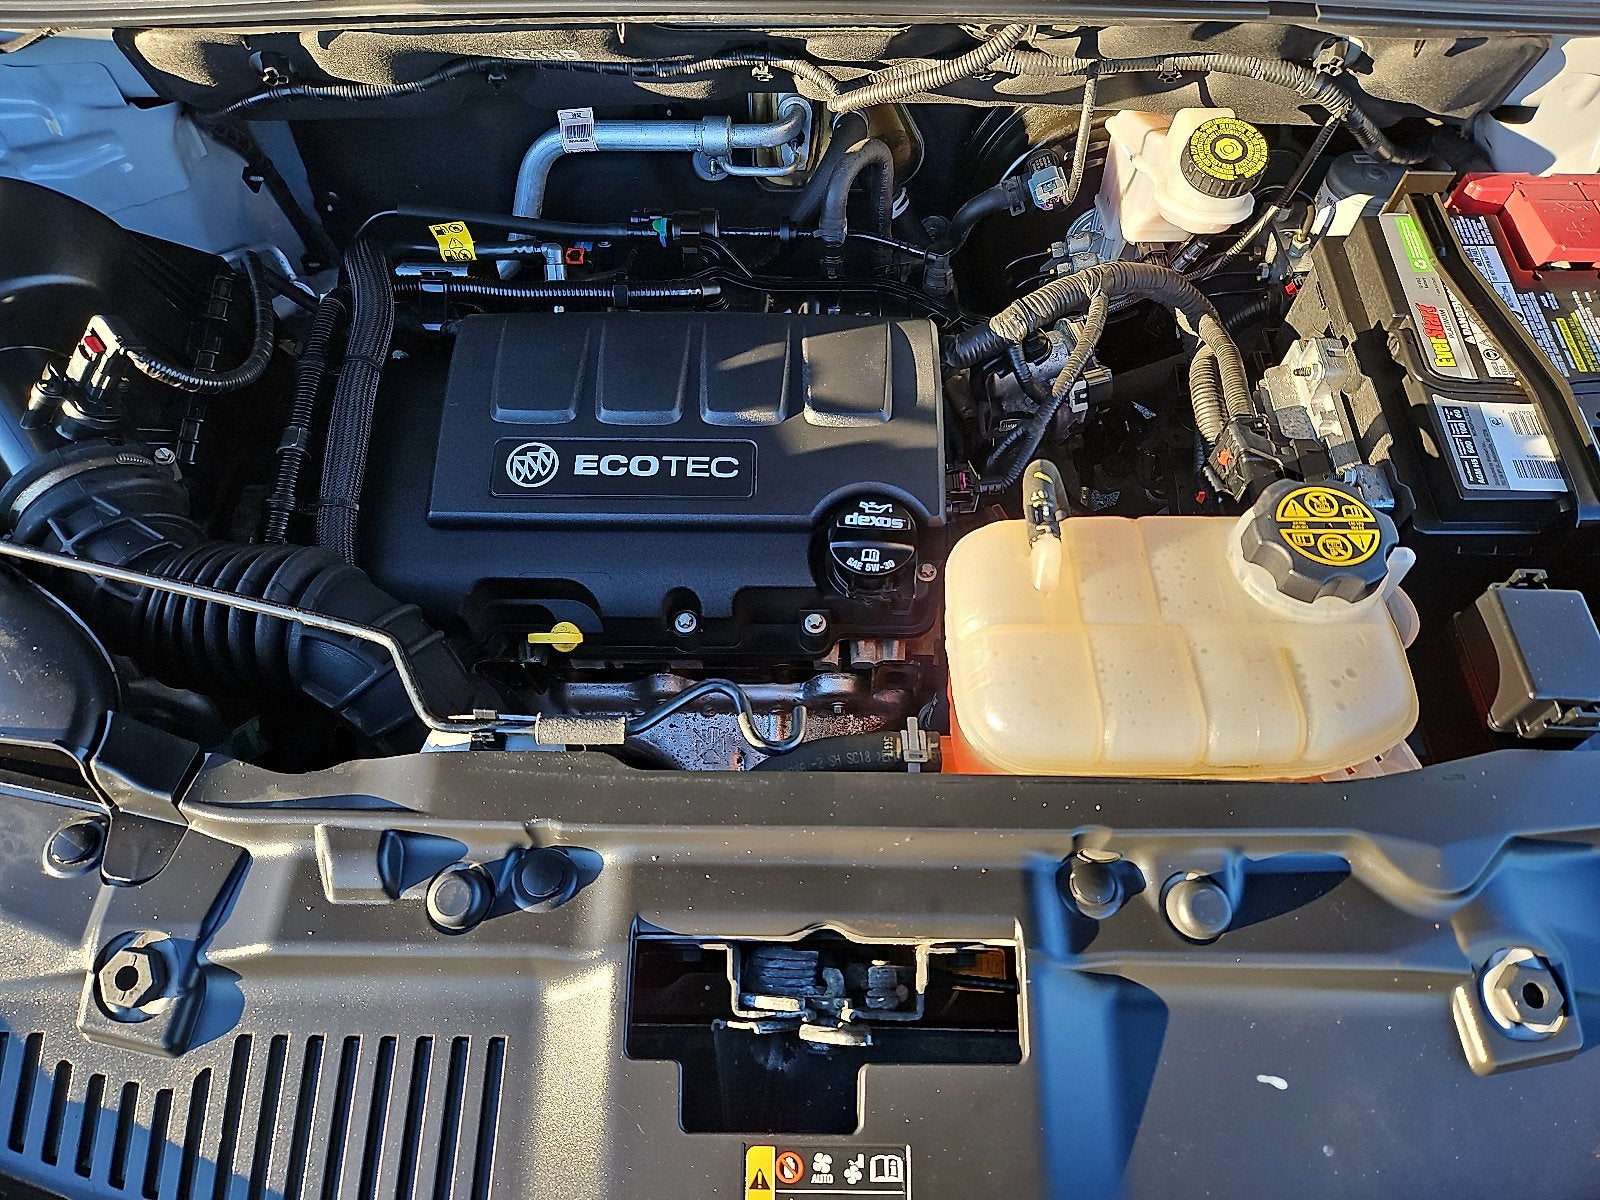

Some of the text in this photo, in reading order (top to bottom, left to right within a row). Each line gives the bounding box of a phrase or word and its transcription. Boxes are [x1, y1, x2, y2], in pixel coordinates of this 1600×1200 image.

[1415, 303, 1457, 367] EverStart
[574, 454, 740, 478] ECOTEC
[844, 512, 904, 529] dexos
[846, 556, 896, 572] SAE 5W-30
[810, 1173, 834, 1184] AUTO
